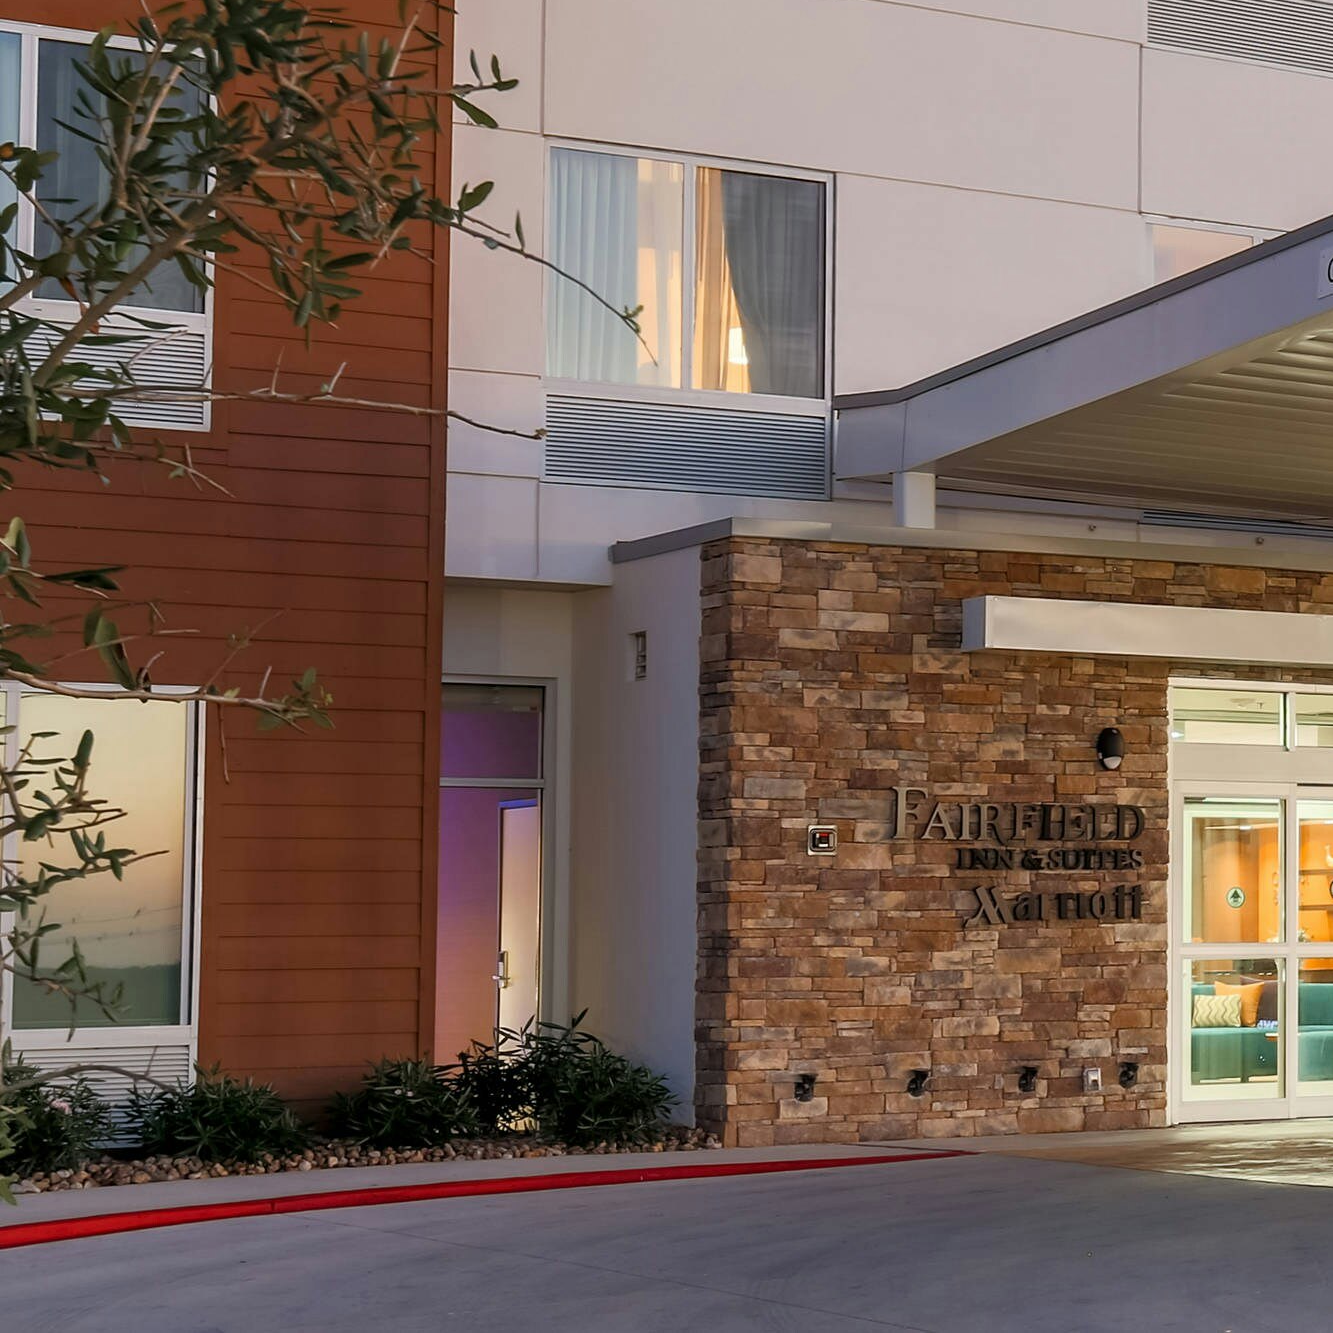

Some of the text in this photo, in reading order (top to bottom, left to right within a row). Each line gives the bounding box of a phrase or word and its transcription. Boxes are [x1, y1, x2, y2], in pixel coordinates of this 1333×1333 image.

[892, 786, 1145, 846] FAIRFIELD
[956, 848, 1146, 871] INN & SUITES
[963, 884, 1144, 929] Marriott
